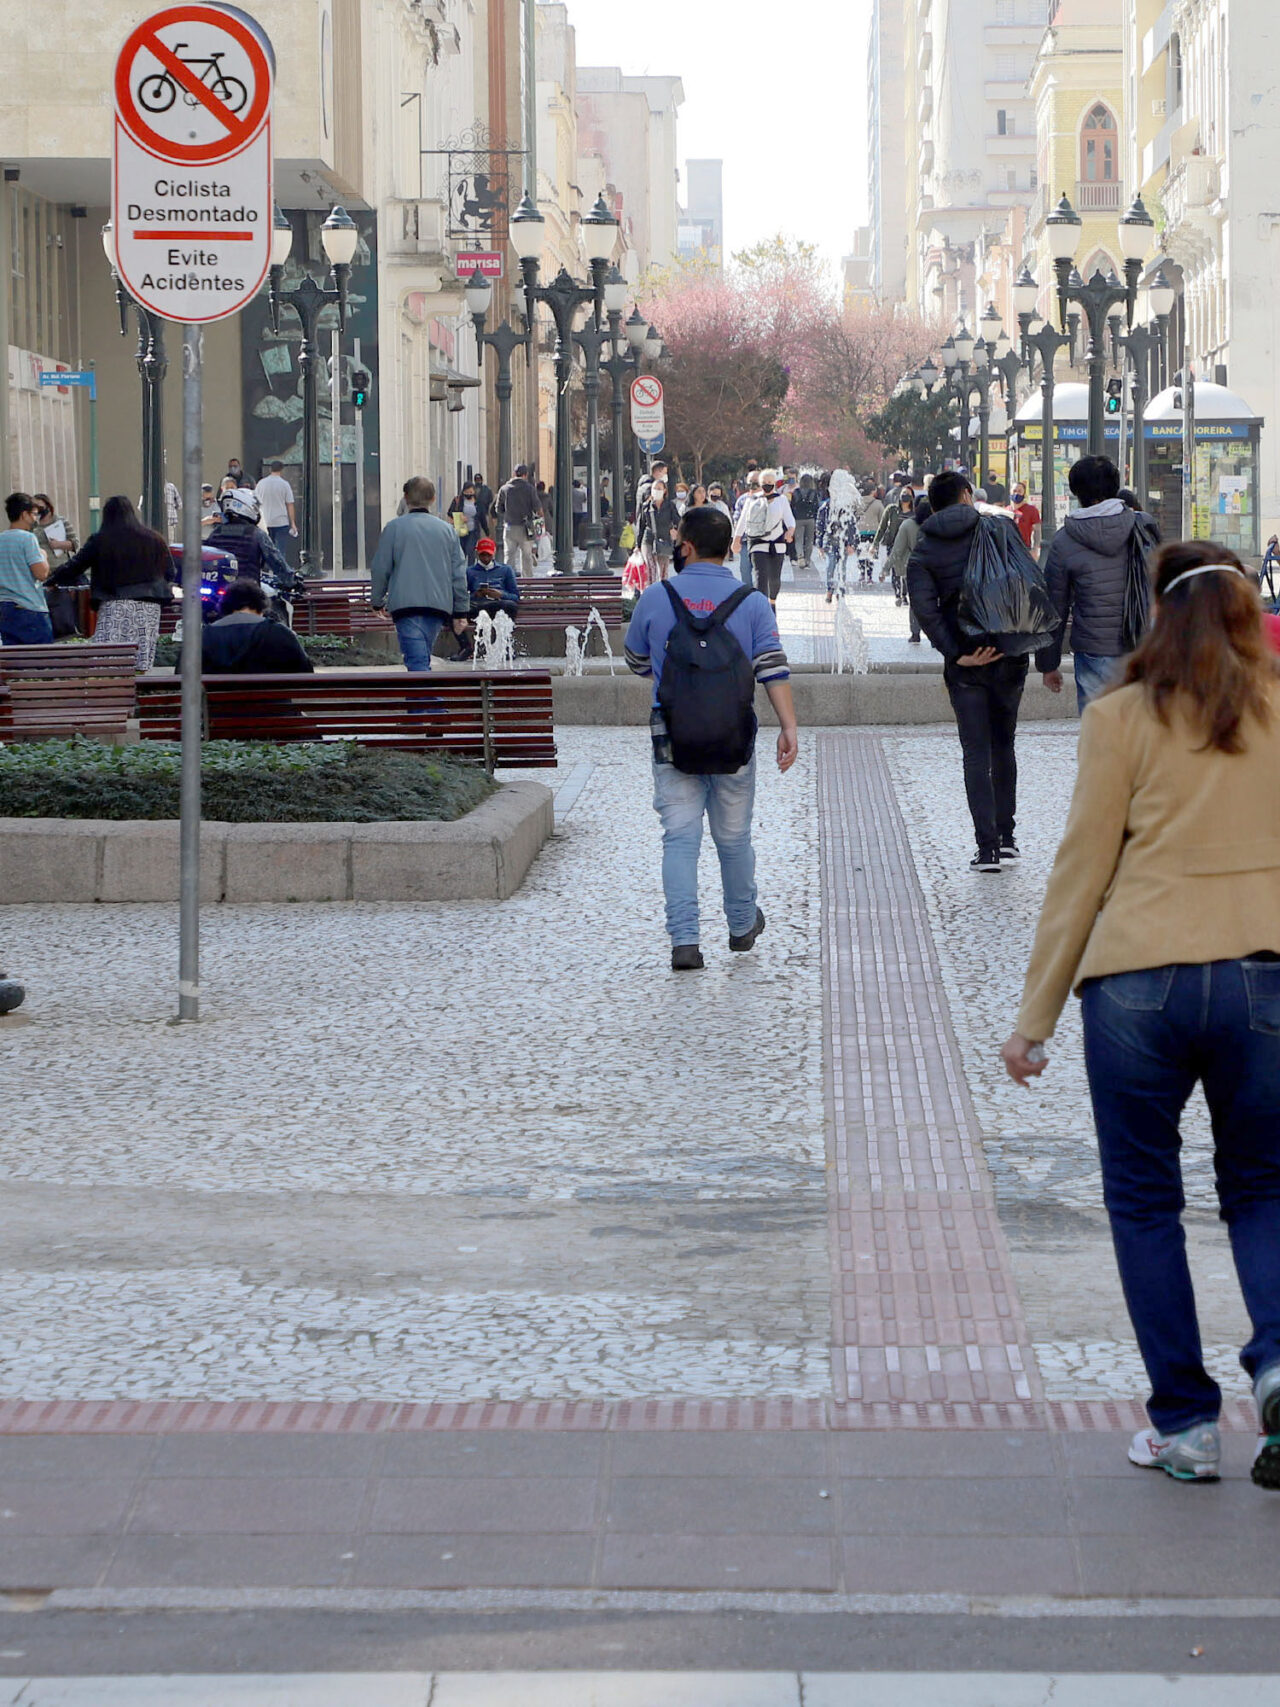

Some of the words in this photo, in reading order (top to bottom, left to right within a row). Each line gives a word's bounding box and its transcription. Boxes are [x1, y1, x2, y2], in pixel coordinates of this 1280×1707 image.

[155, 180, 230, 197] Ciclista
[128, 204, 258, 222] Desmontado
[168, 249, 218, 266] Evite
[457, 259, 500, 269] marisa
[141, 274, 245, 291] Acidentes
[1063, 428, 1075, 436] TIM
[1152, 426, 1184, 435] BANCA
[1194, 425, 1233, 435] OREIRA
